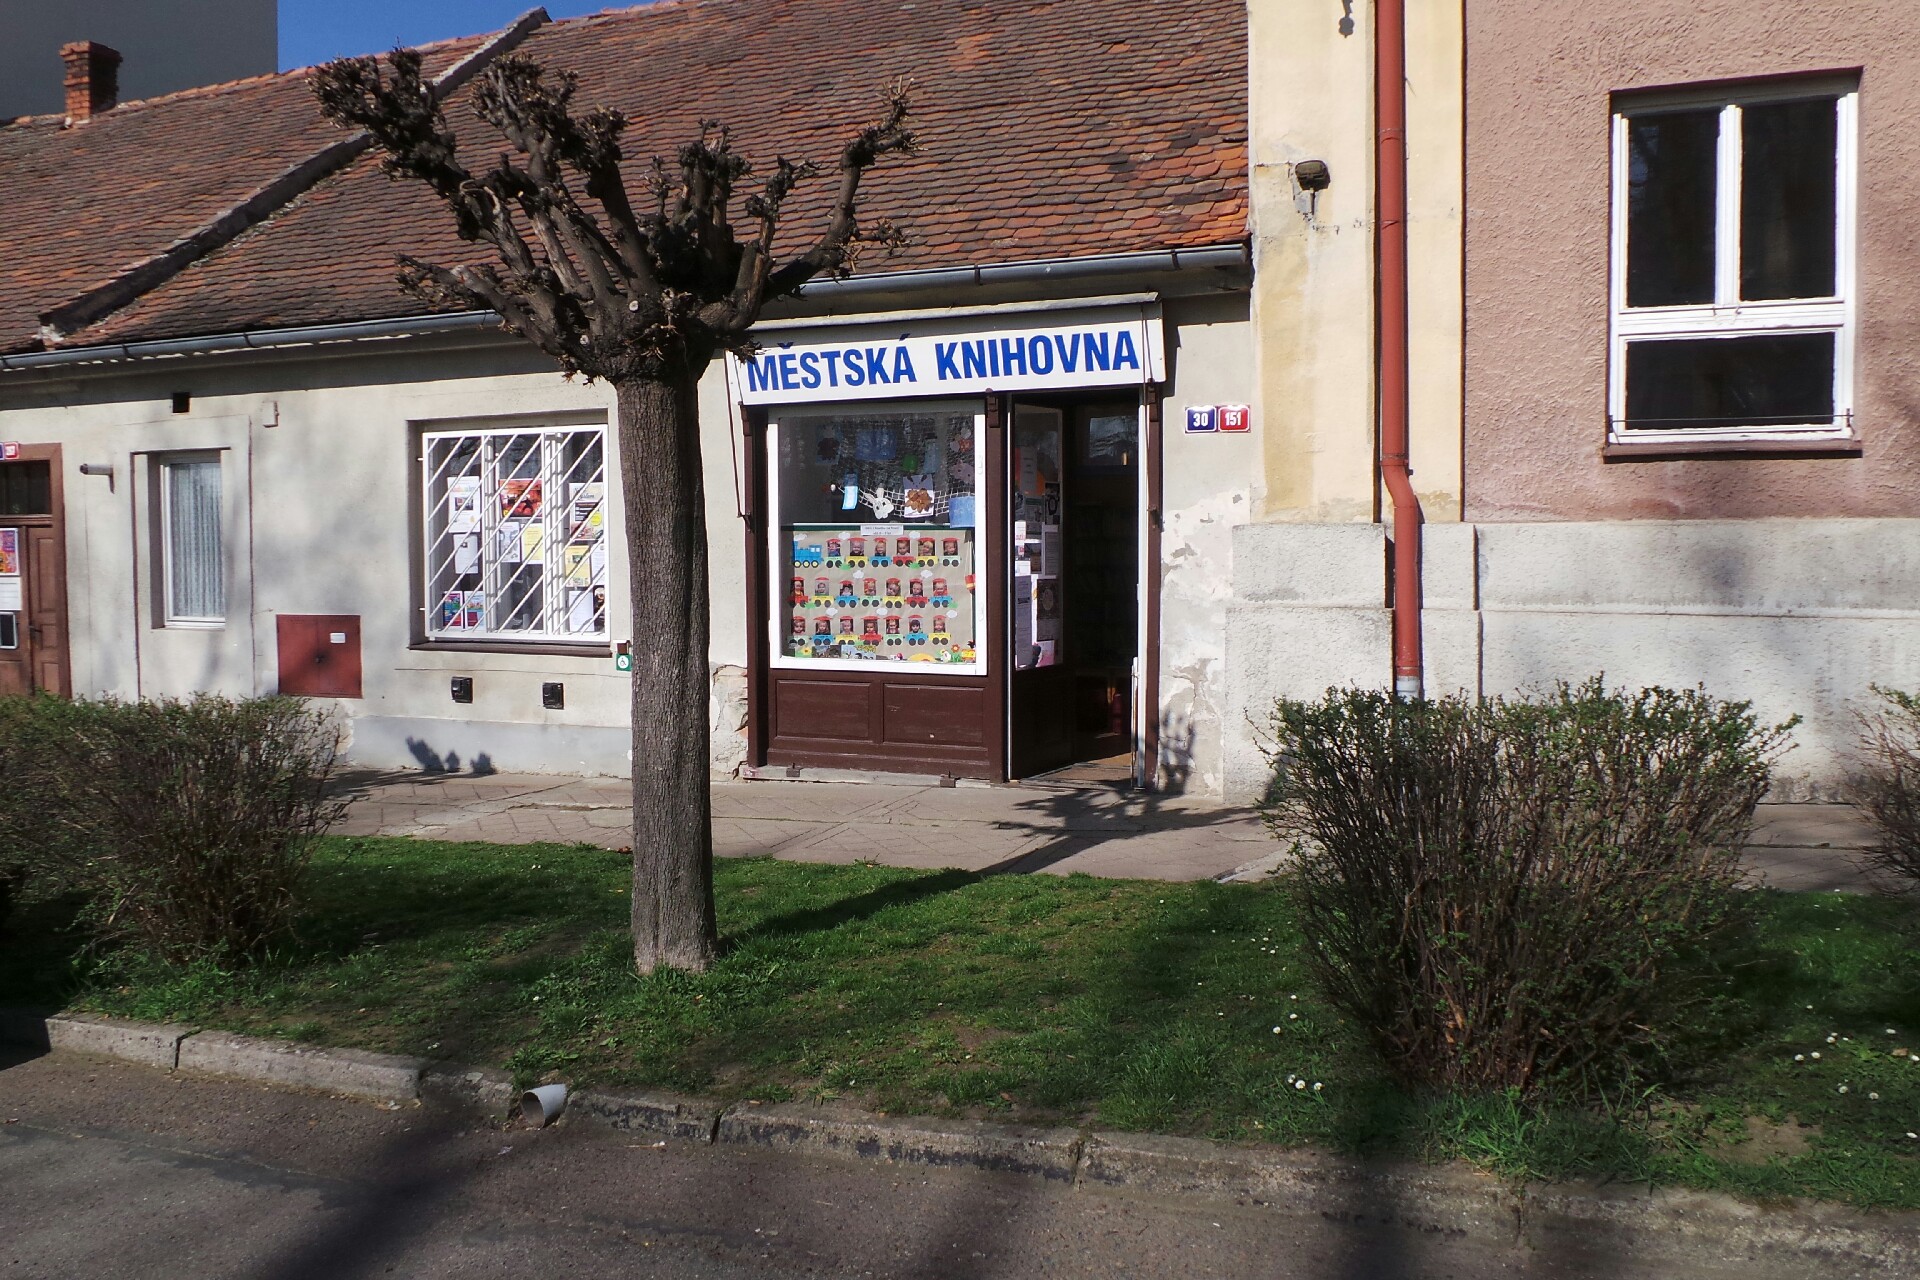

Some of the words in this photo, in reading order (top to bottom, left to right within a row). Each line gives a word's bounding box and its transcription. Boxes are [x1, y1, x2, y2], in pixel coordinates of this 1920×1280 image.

[747, 333, 917, 392] MĚSTSKÁ
[935, 330, 1140, 380] KNIHOVNA
[1193, 413, 1209, 427] 30
[1225, 411, 1242, 426] 151
